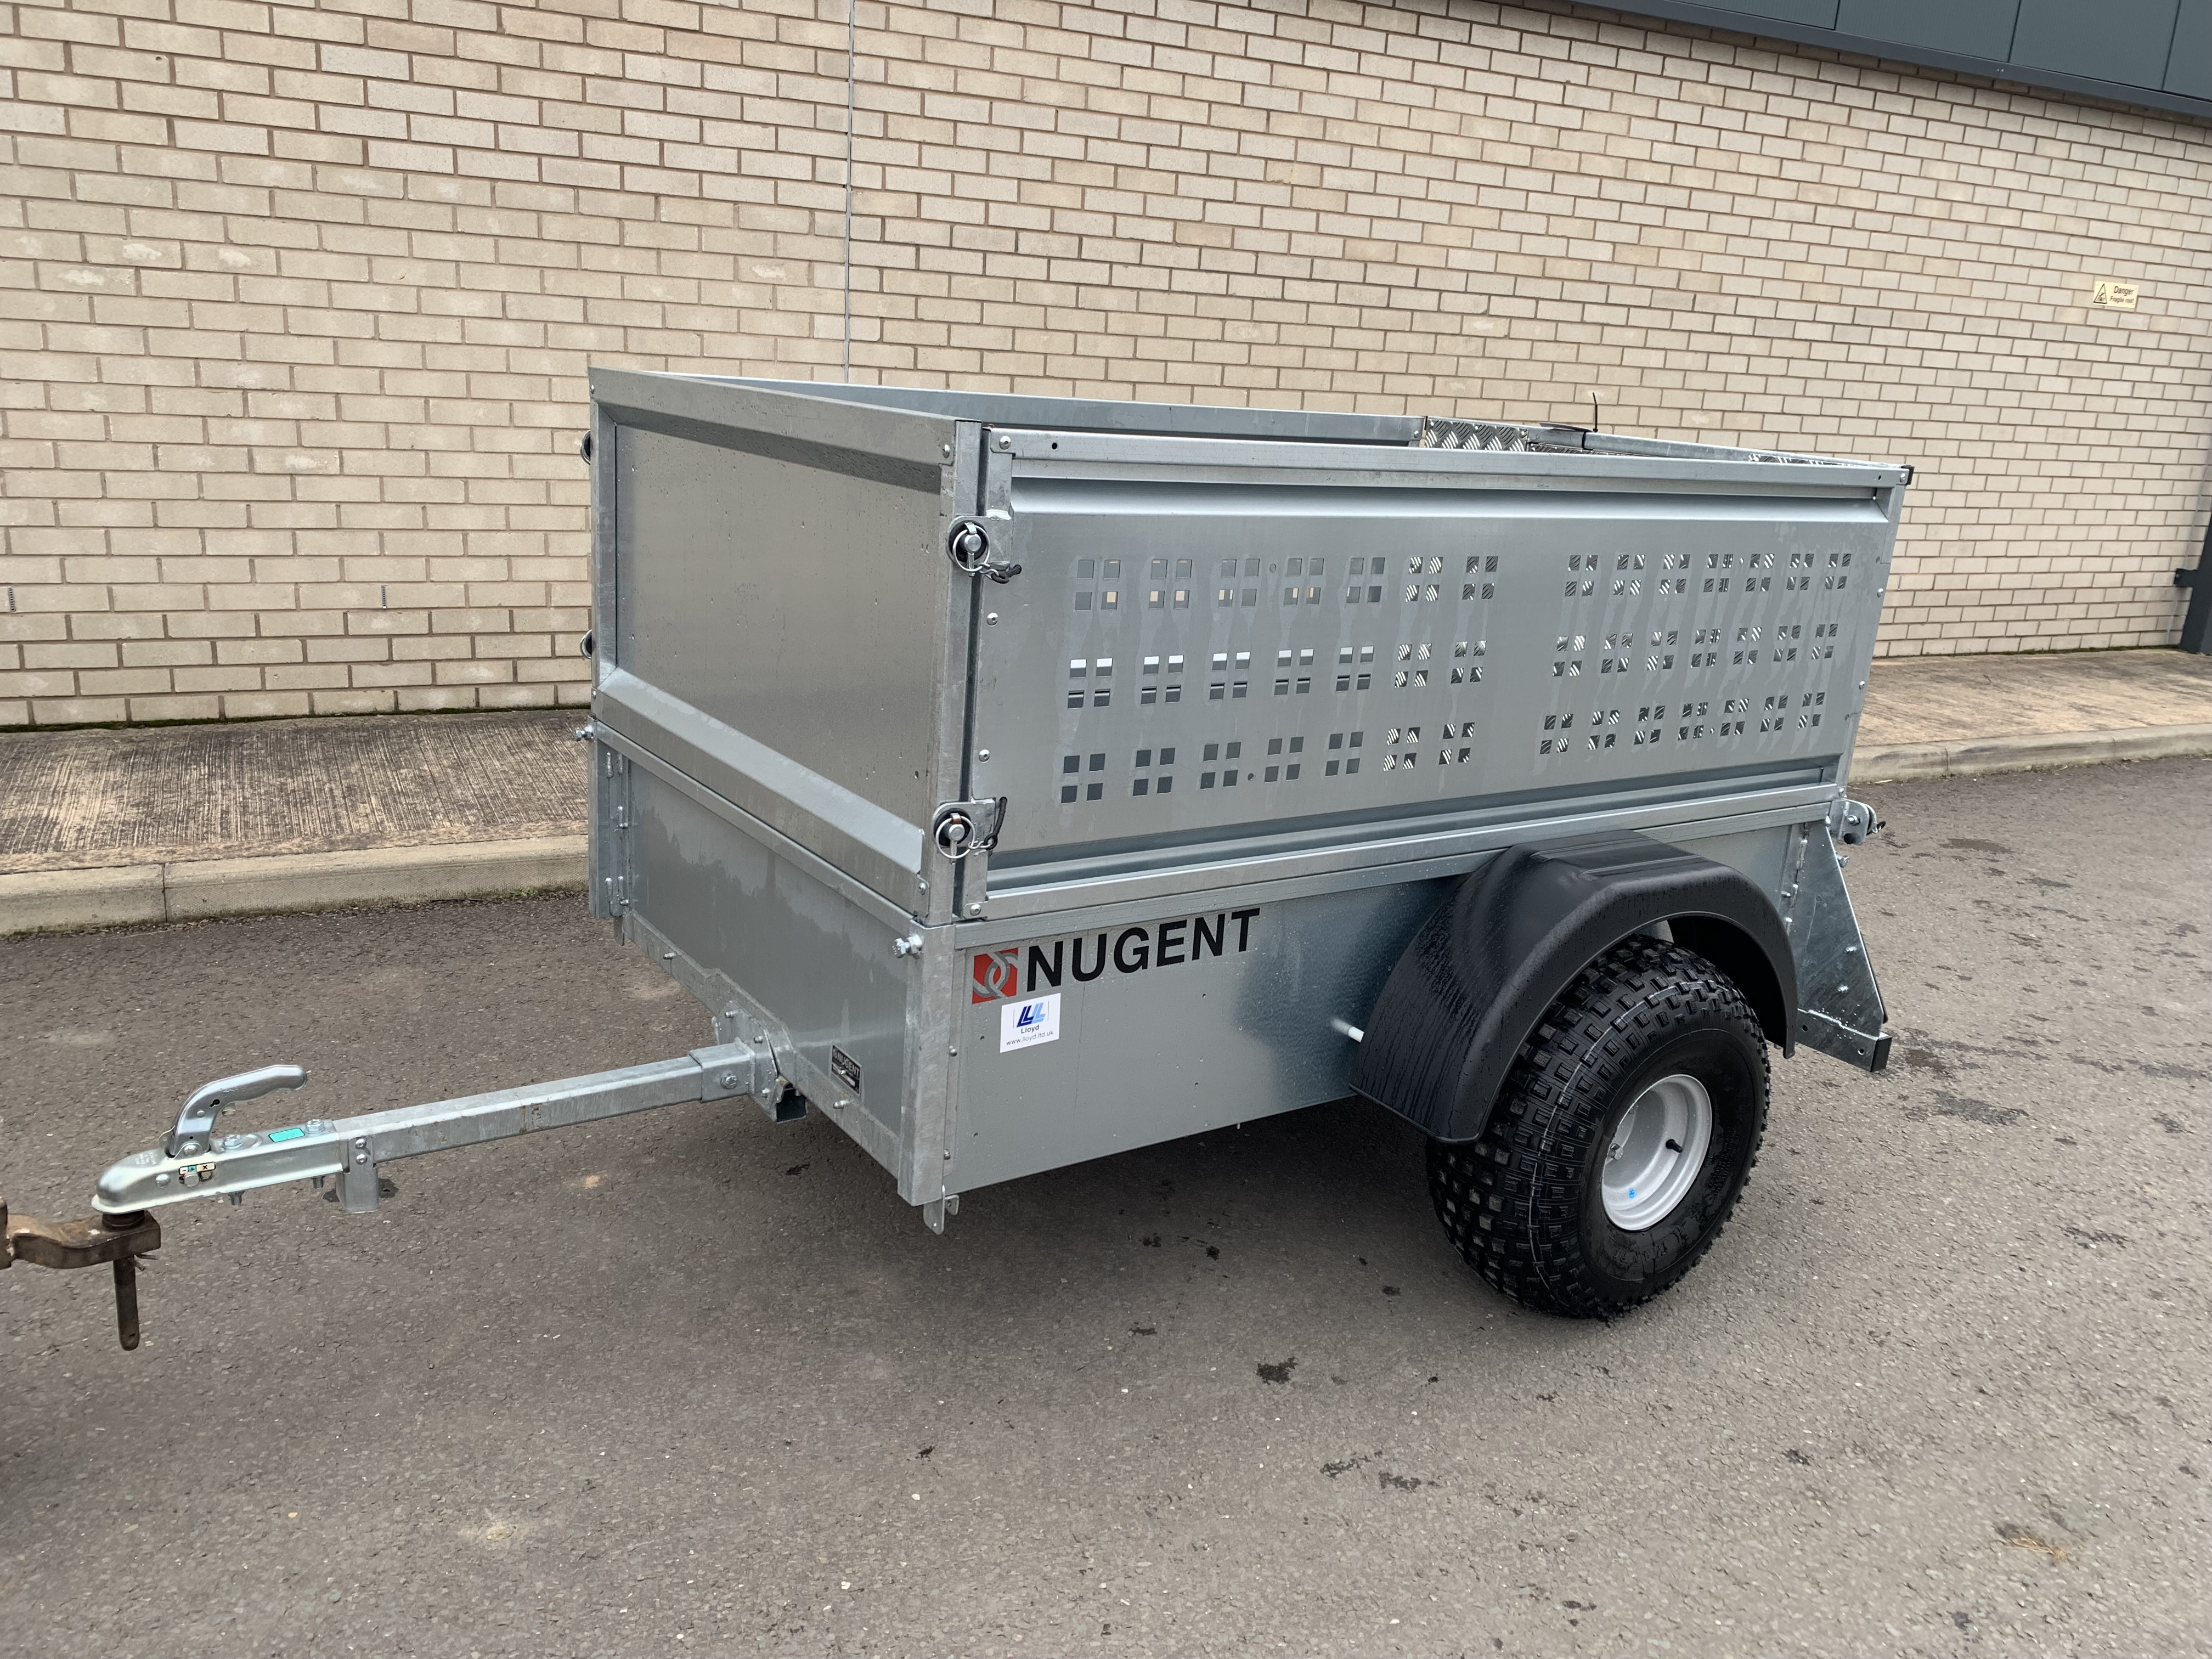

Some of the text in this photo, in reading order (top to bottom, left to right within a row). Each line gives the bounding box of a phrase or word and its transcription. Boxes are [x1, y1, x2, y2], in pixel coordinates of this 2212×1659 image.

[2114, 286, 2134, 296] Danger
[1027, 907, 1260, 992] NUGENT
[1021, 1024, 1039, 1034] Lloyd
[1006, 1030, 1054, 1046] www.lloyd.ltd.uk
